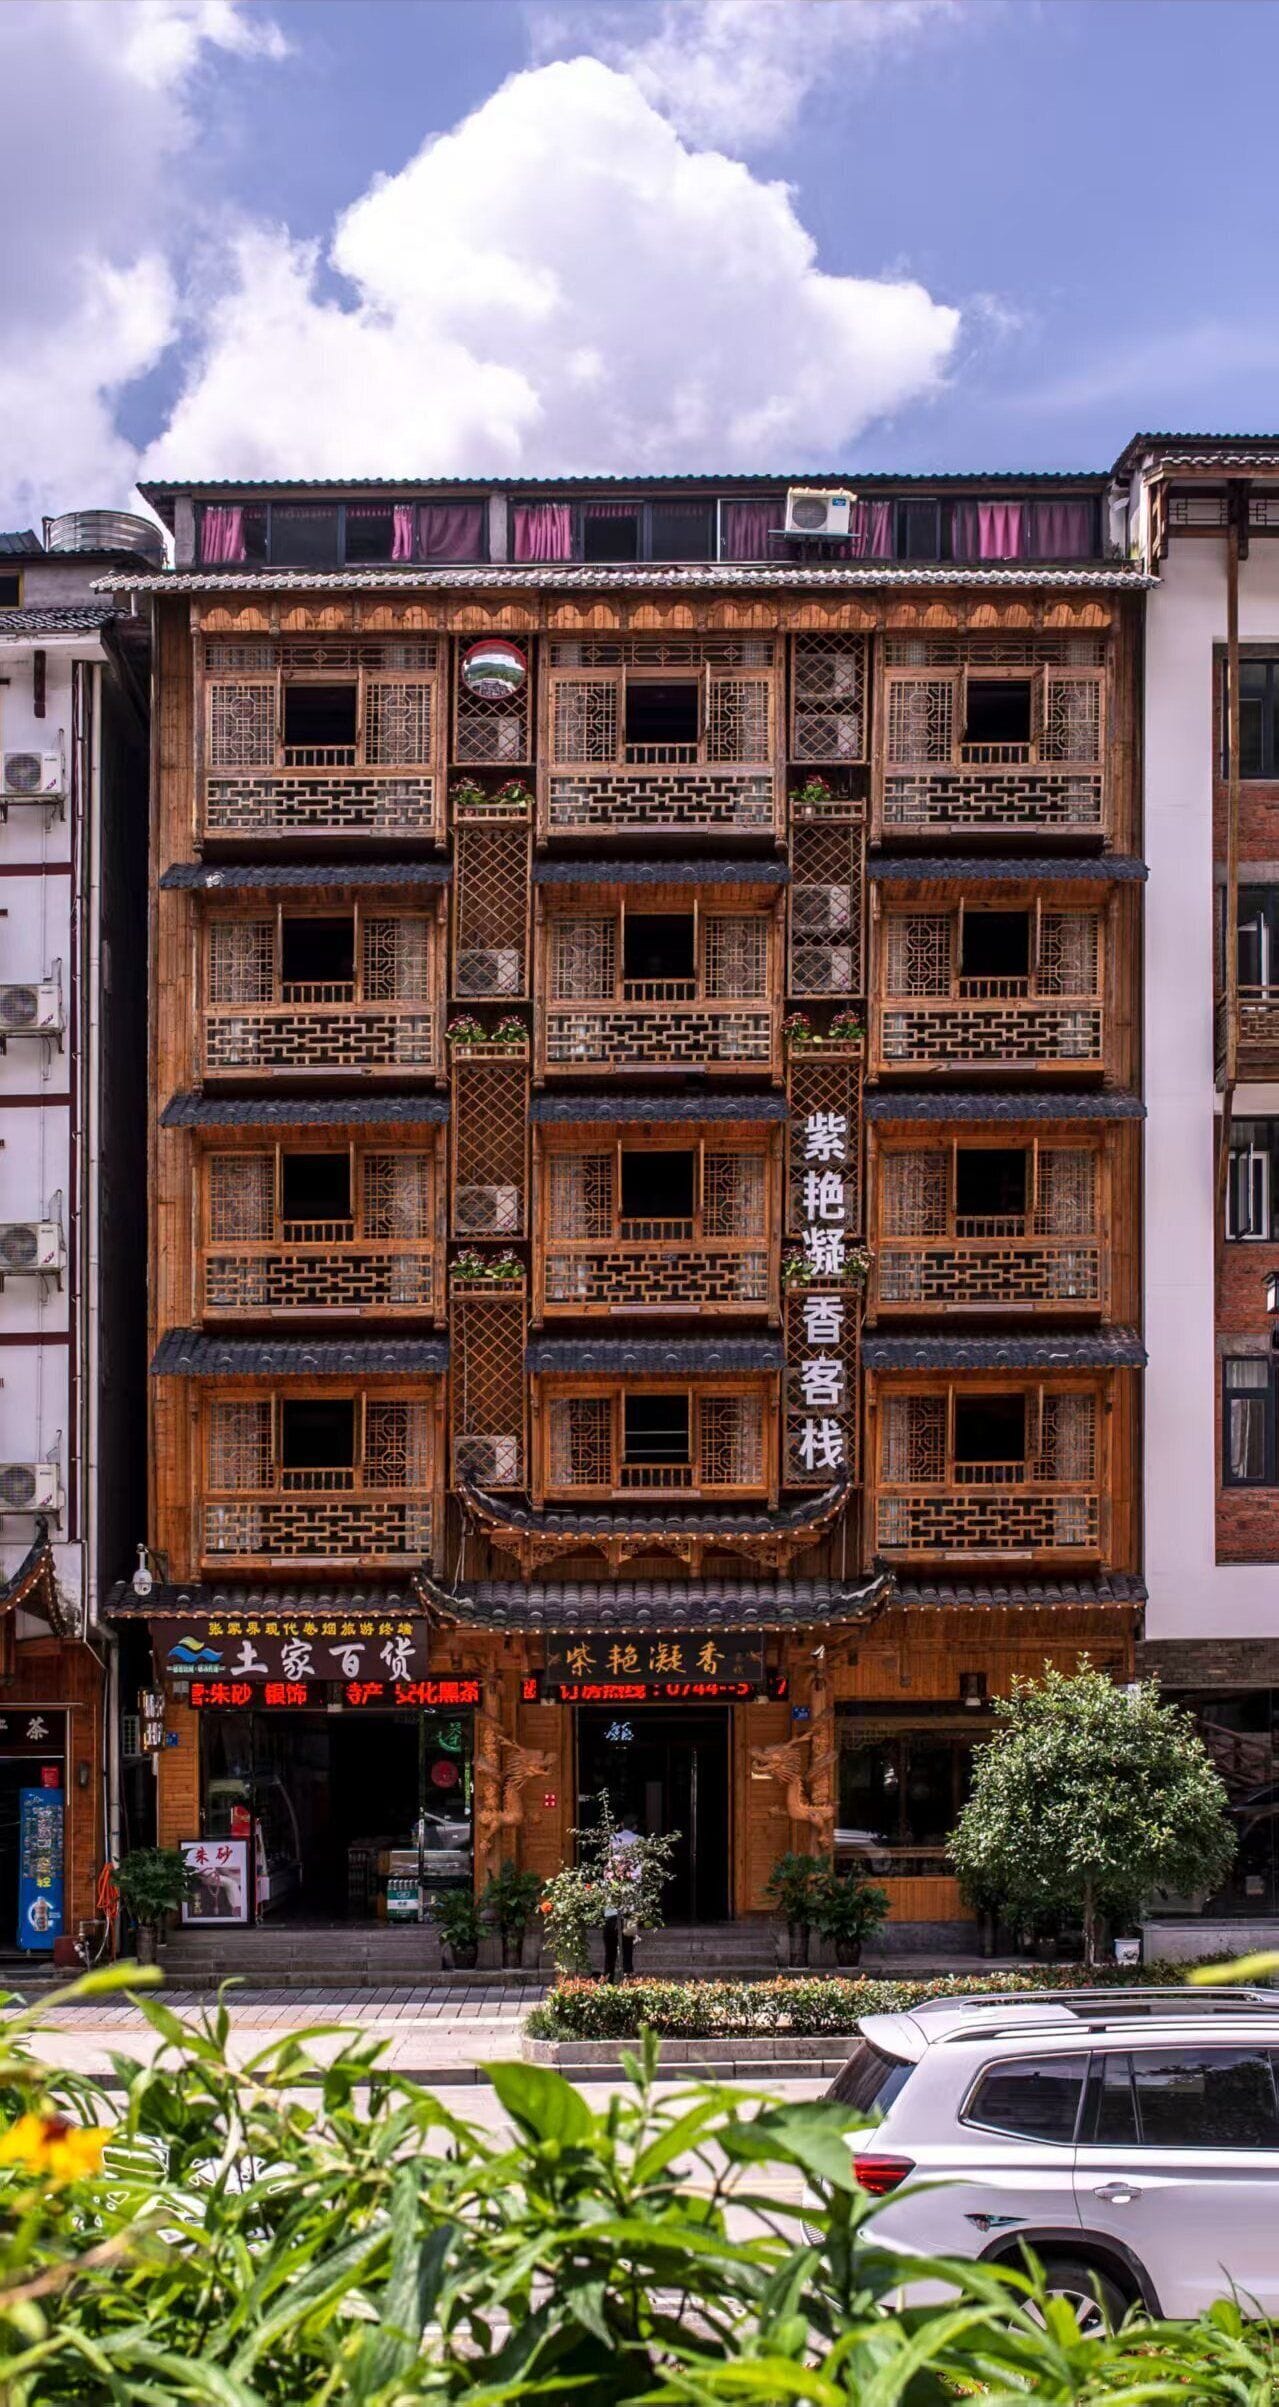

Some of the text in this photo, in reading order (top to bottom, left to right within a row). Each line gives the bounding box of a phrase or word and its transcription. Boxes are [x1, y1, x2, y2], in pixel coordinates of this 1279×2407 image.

[799, 1112, 848, 1471] 紫艳凝香客栈
[230, 1636, 416, 1681] 土家百货
[566, 1641, 726, 1677] 紫艳凝香
[195, 1846, 233, 1866] 朱砂
